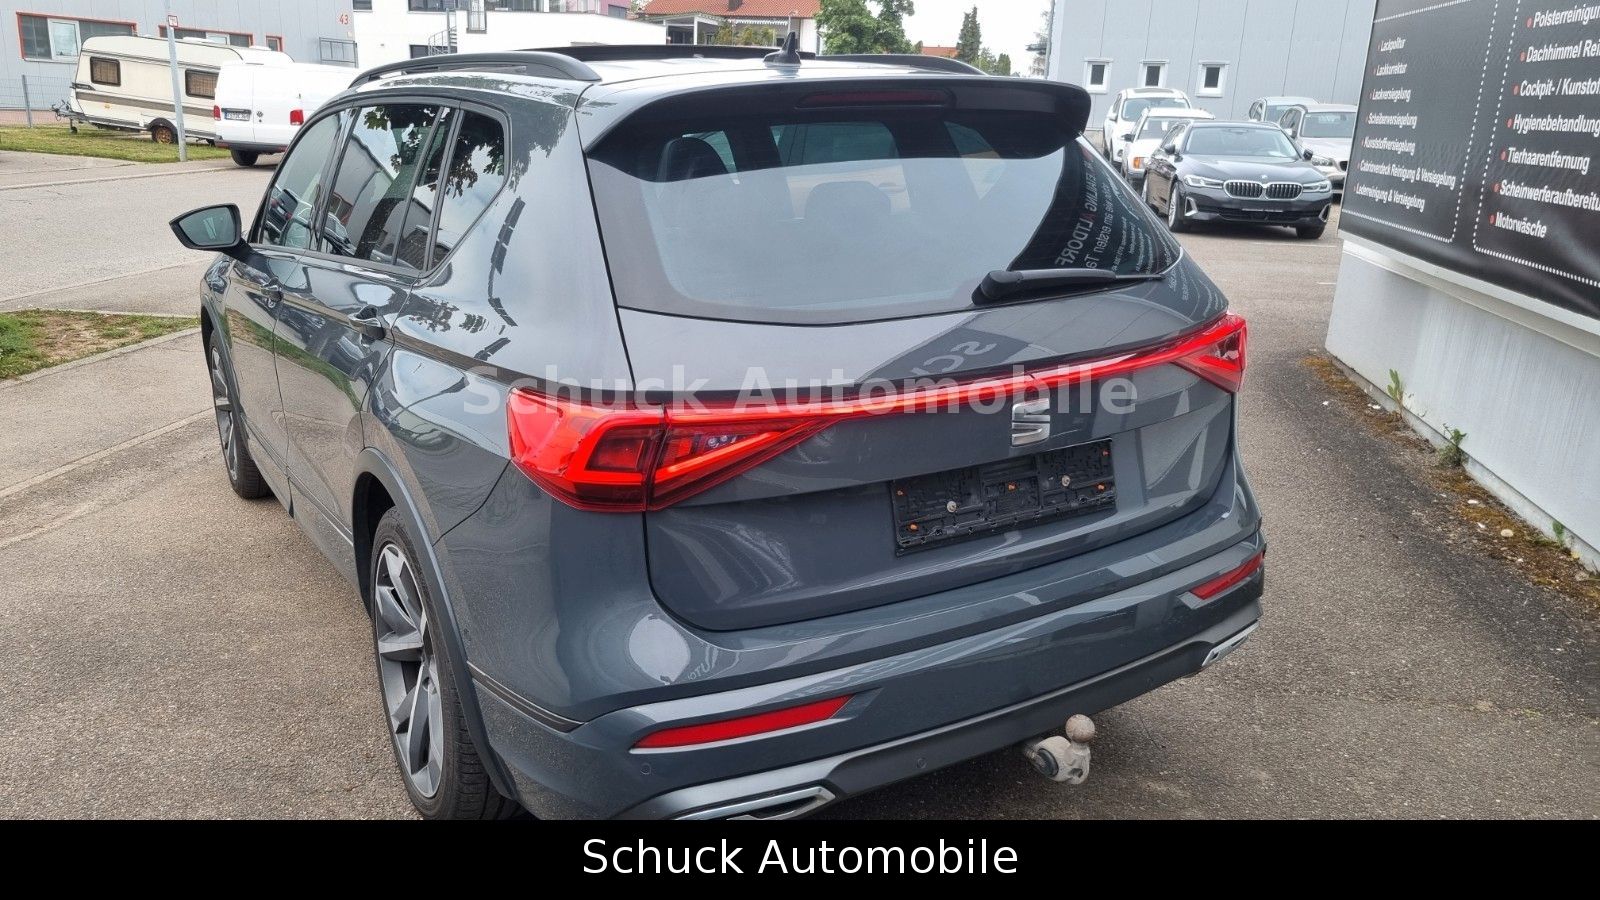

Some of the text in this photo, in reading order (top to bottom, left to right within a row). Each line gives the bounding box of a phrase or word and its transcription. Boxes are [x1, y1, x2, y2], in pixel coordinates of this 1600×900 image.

[339, 13, 349, 25] 43
[1380, 37, 1406, 53] Lackpolitur
[1526, 39, 1600, 62] Dachhimmel Rei
[1376, 63, 1408, 77] Lackkorrektur
[1372, 87, 1411, 102] Lackversiegelung
[1520, 78, 1555, 100] Cockpit-
[1513, 114, 1600, 137] Hygienebehandlung
[1507, 147, 1590, 175] Tierhaarentfernung
[1391, 163, 1416, 183] Reinigung
[1416, 167, 1421, 181] &
[1421, 168, 1456, 190] Versiegelung
[1388, 189, 1393, 202] &
[1393, 190, 1425, 213] Versiegelung
[1495, 212, 1547, 238] Motorwäsche
